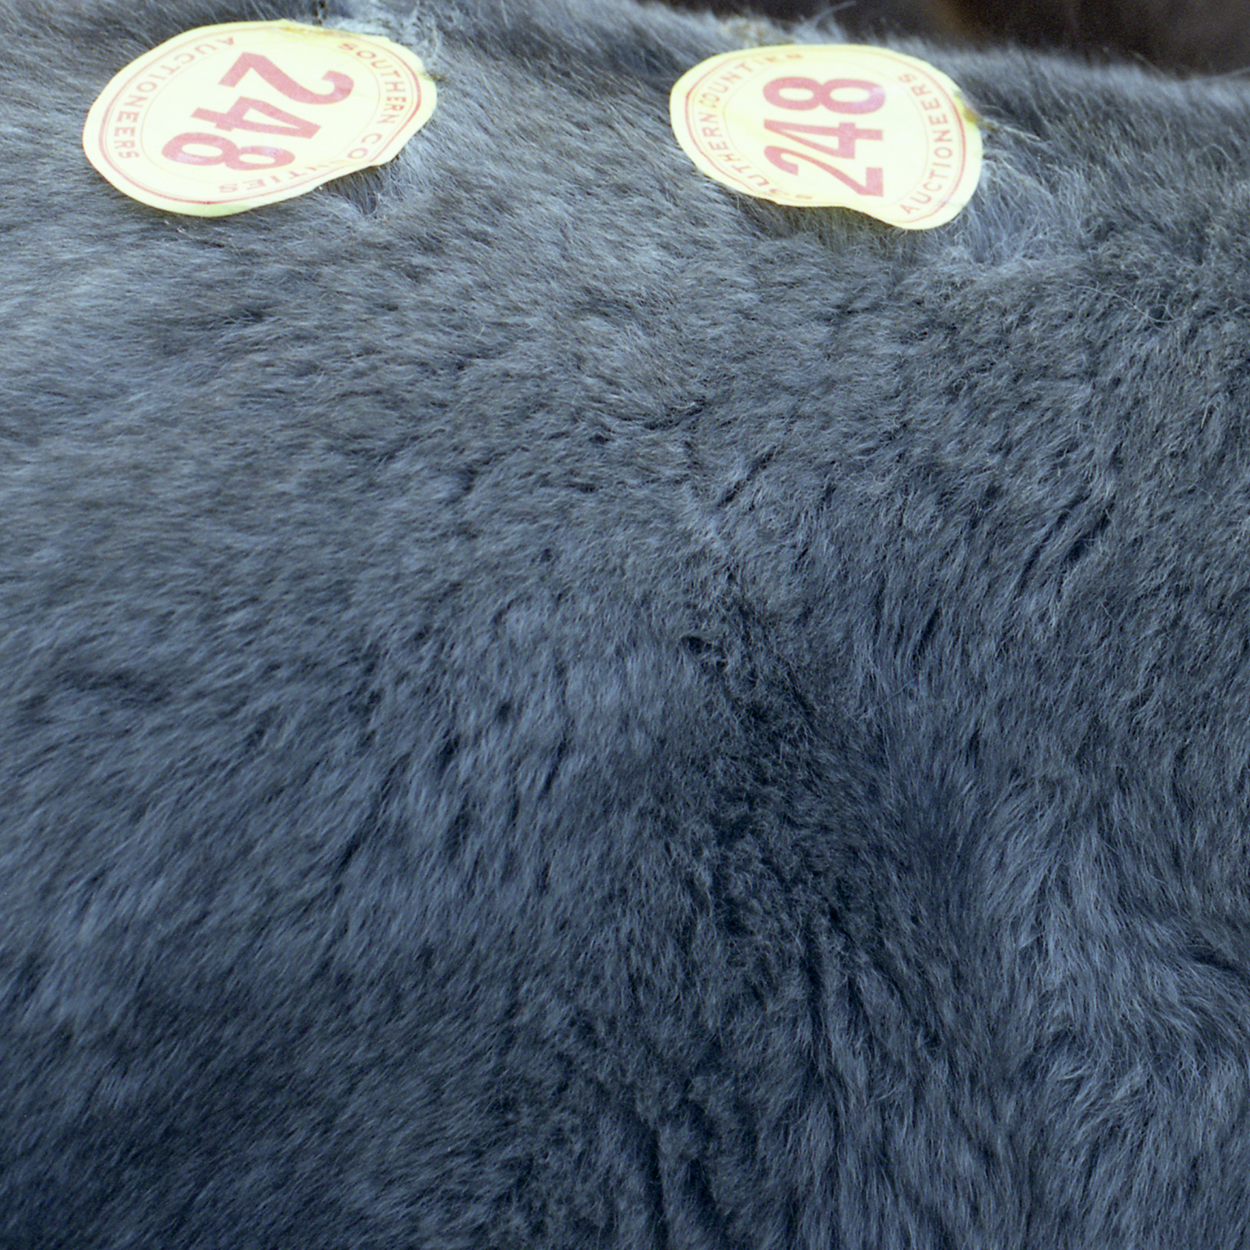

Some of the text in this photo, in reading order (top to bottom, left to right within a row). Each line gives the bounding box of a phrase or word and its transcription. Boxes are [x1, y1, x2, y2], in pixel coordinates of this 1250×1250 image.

[113, 36, 235, 160] AUCTIONEERS
[161, 52, 355, 171] 248
[338, 41, 407, 125] SOUTHERN
[762, 76, 886, 197] 248
[898, 73, 954, 215] AUCTIONEERS
